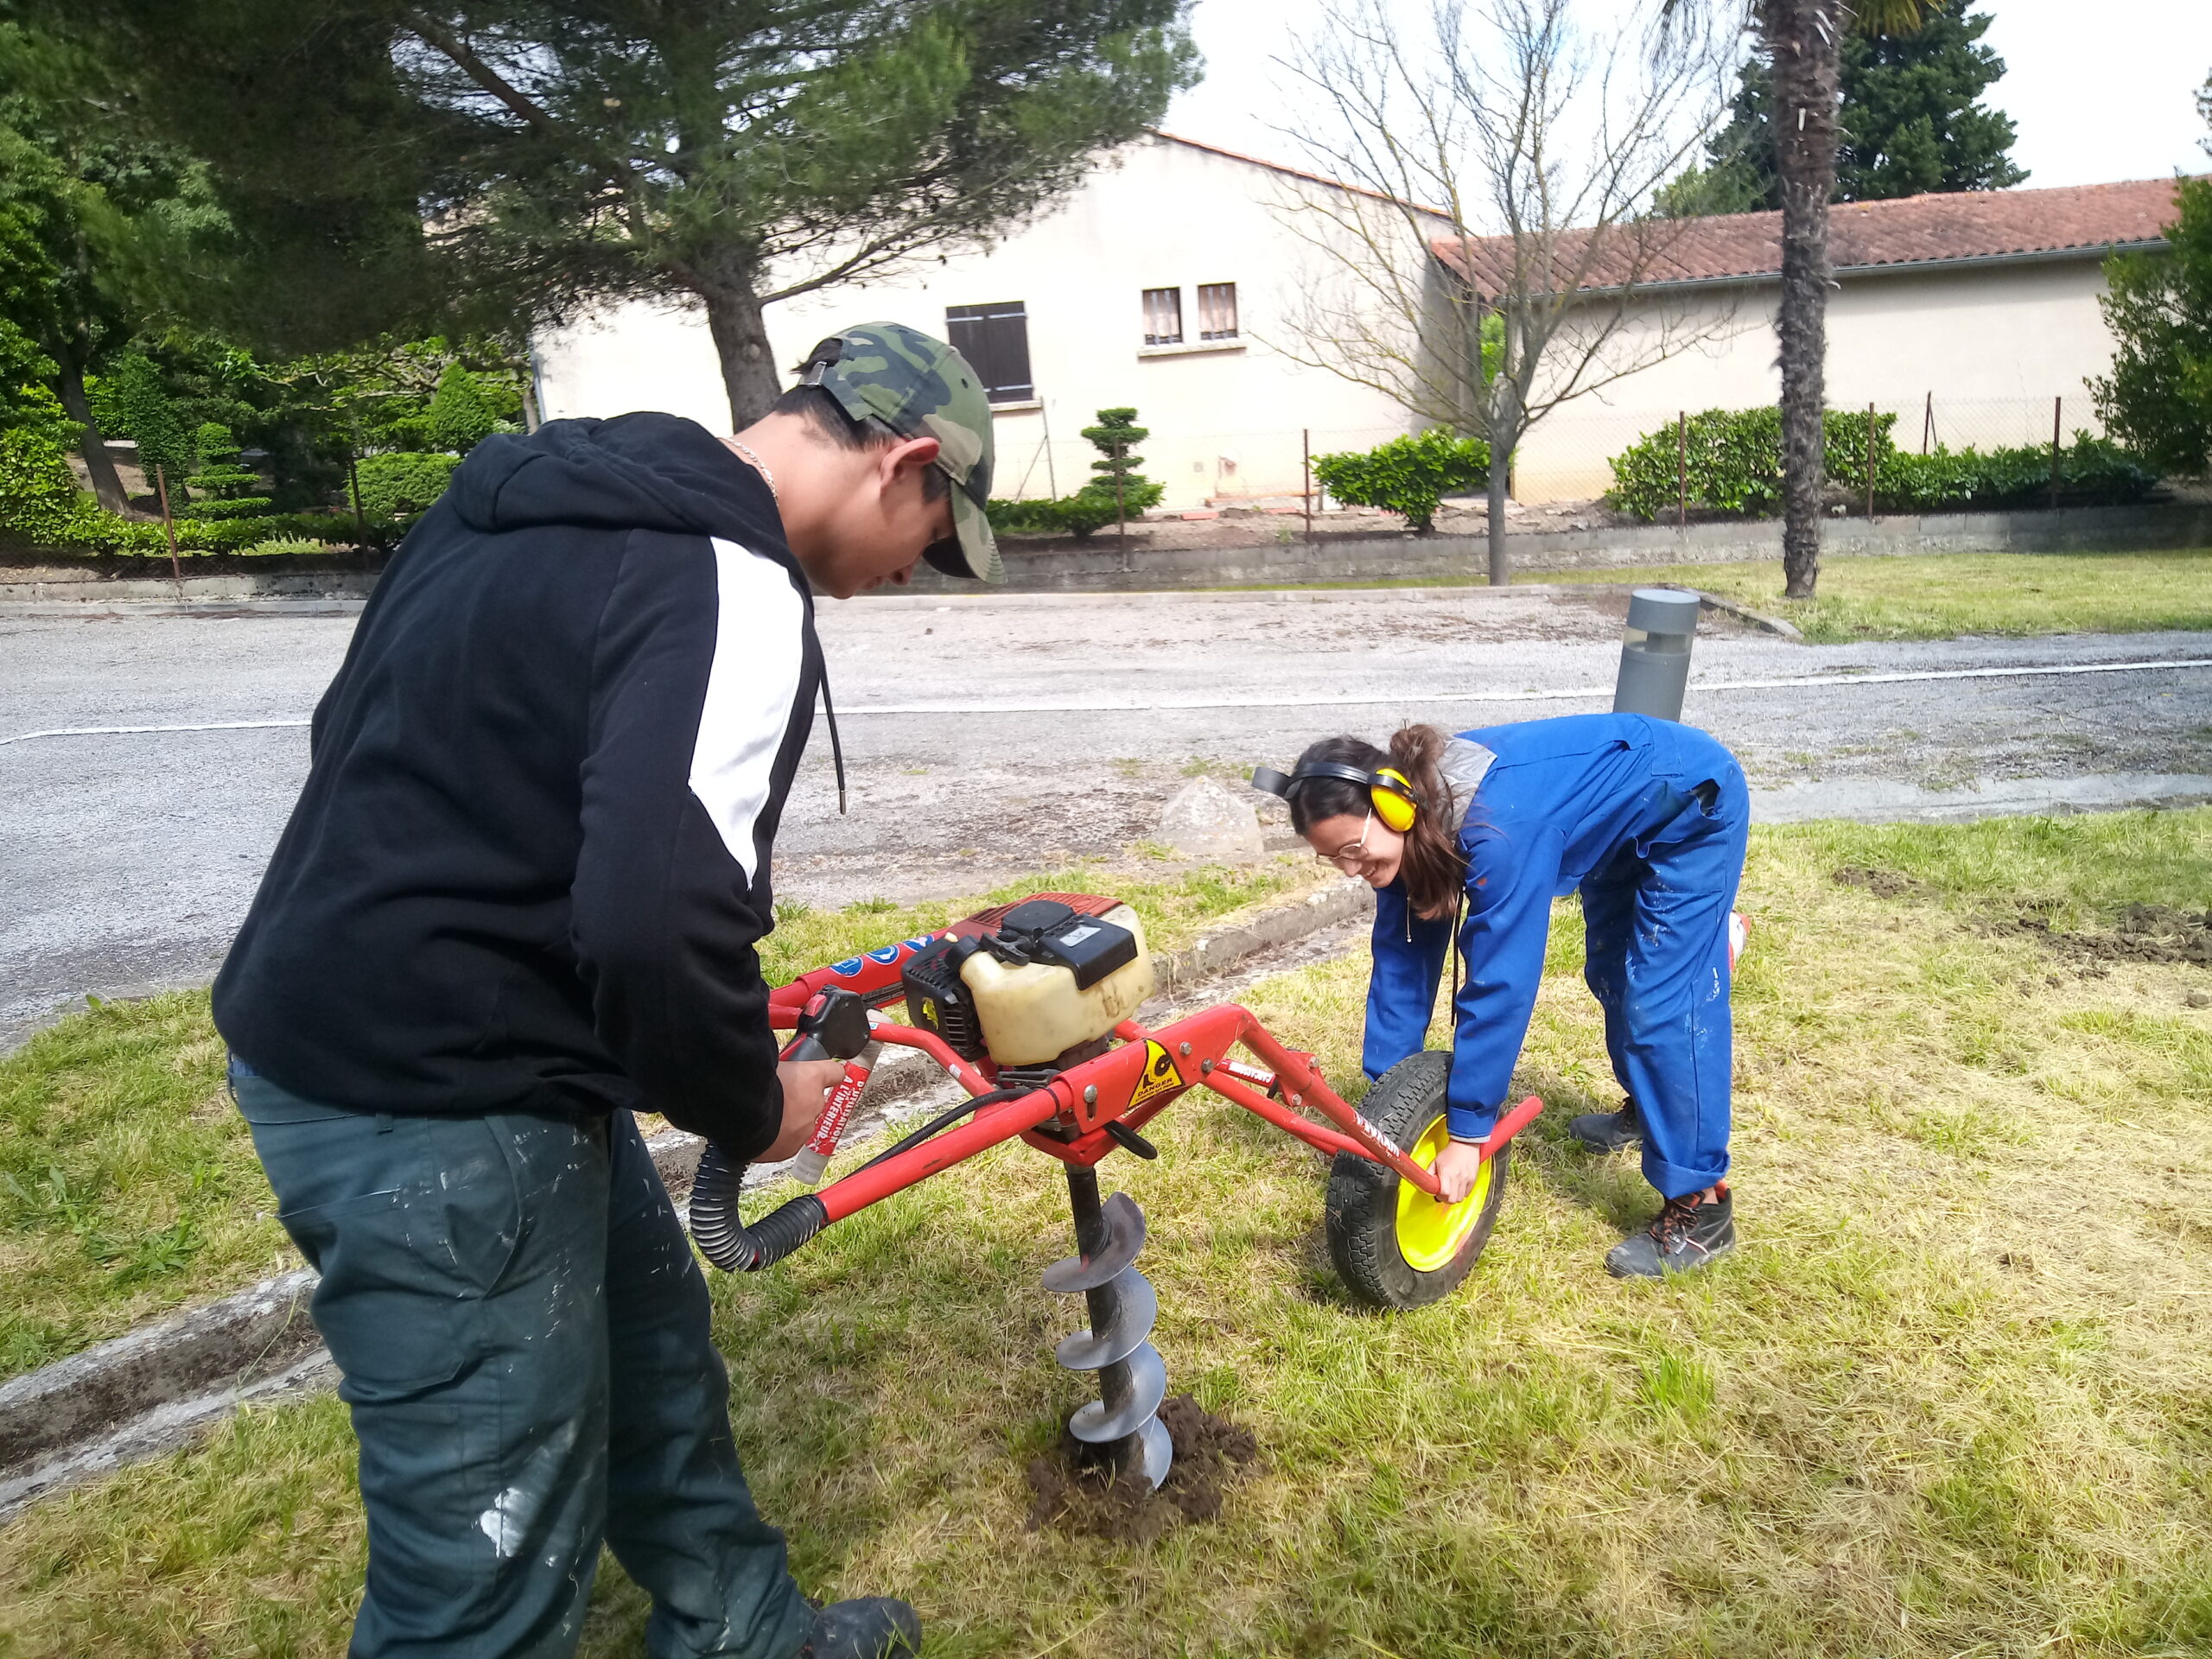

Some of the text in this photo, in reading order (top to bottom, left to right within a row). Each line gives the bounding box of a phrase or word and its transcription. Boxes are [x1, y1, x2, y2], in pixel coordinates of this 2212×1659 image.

[817, 1075, 854, 1140] A L'INTERIEUR
[829, 1080, 865, 1143] D'UTILISATION
[1137, 1077, 1173, 1096] DANGER
